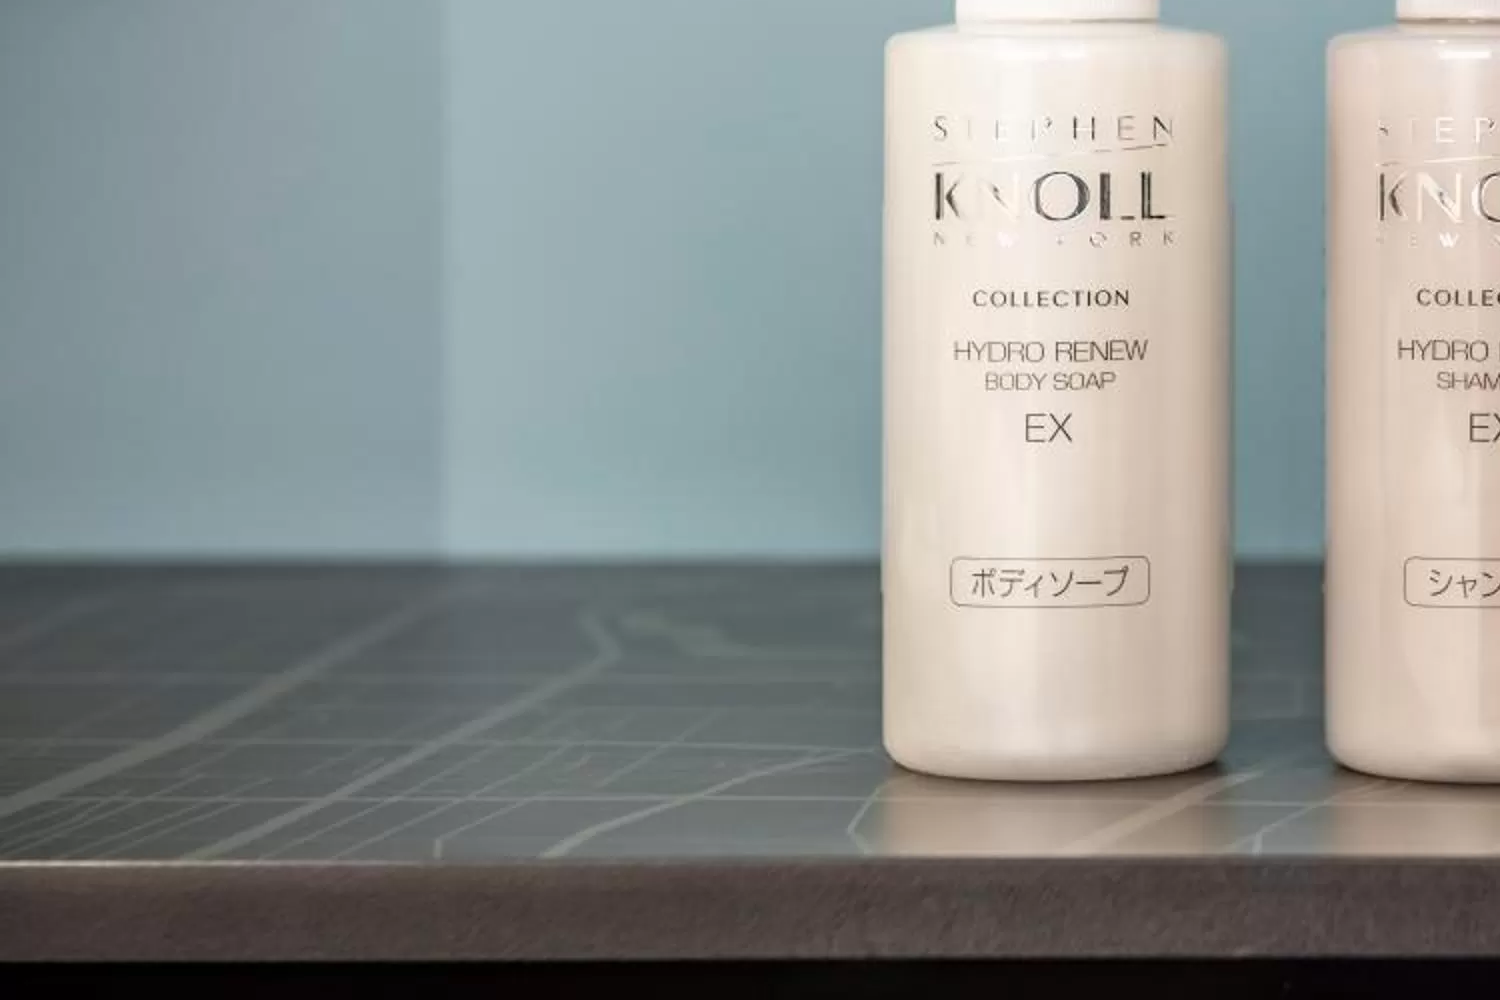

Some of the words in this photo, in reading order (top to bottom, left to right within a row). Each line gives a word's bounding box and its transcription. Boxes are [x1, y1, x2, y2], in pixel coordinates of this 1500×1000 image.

[934, 171, 1175, 221] KNOLL
[972, 289, 1130, 308] COLLECTION
[953, 341, 1045, 363] HYDRO
[1055, 339, 1149, 362] RENEW
[1397, 339, 1489, 363] HYDRO
[985, 372, 1048, 391] BODY
[1052, 371, 1116, 391] SOAP
[1025, 412, 1073, 443] EX
